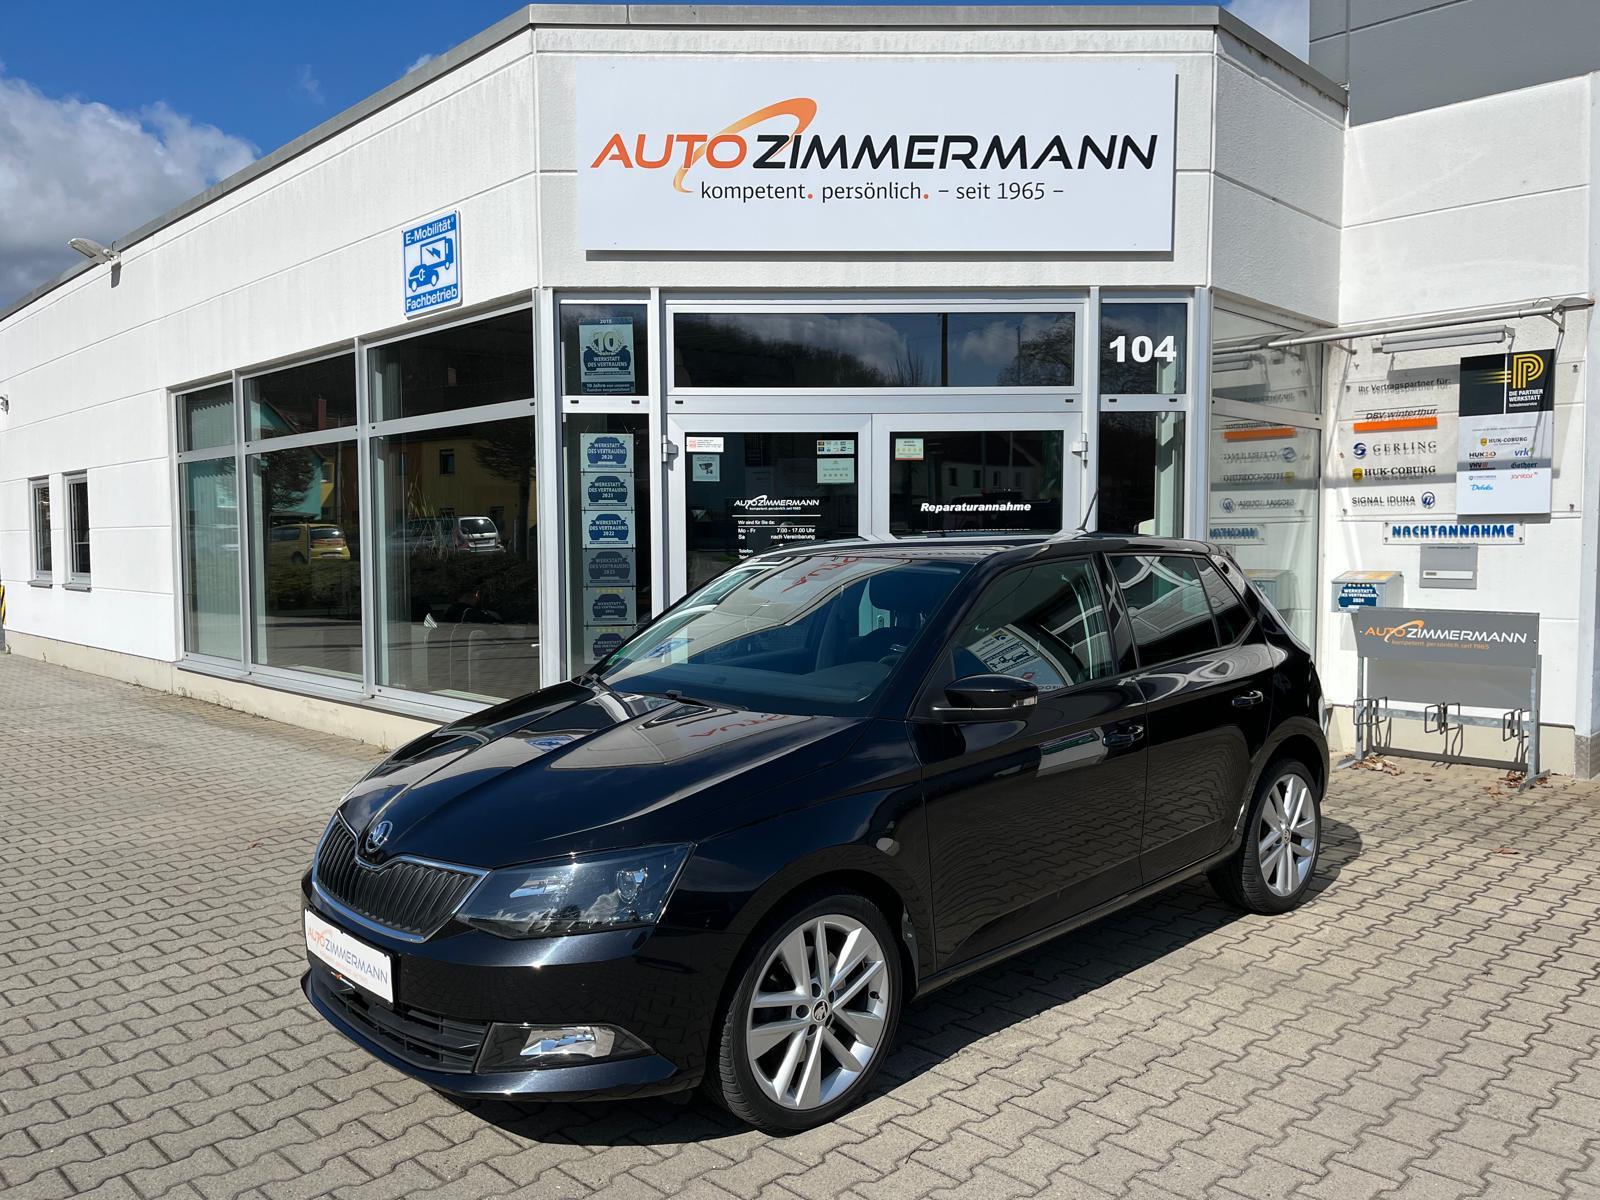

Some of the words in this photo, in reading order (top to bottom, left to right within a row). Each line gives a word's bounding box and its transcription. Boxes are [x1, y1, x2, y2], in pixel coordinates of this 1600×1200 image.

[701, 181, 814, 203] kompetent.
[821, 180, 930, 203] persönlich.
[955, 182, 991, 199] seit
[997, 182, 1046, 199] 1965
[405, 218, 451, 245] E-Mobilität
[406, 286, 458, 311] Fachbetrieb
[1109, 335, 1177, 363] 104
[1371, 380, 1434, 392] Vertragspartner
[1372, 441, 1437, 453] GERLING
[1364, 466, 1436, 476] HUK-COBURG
[1351, 496, 1384, 505] SIGNAL
[1386, 495, 1416, 504] IDUNA
[920, 502, 1032, 513] Reparaturannahme
[1391, 524, 1515, 538] NACHTANNAHME
